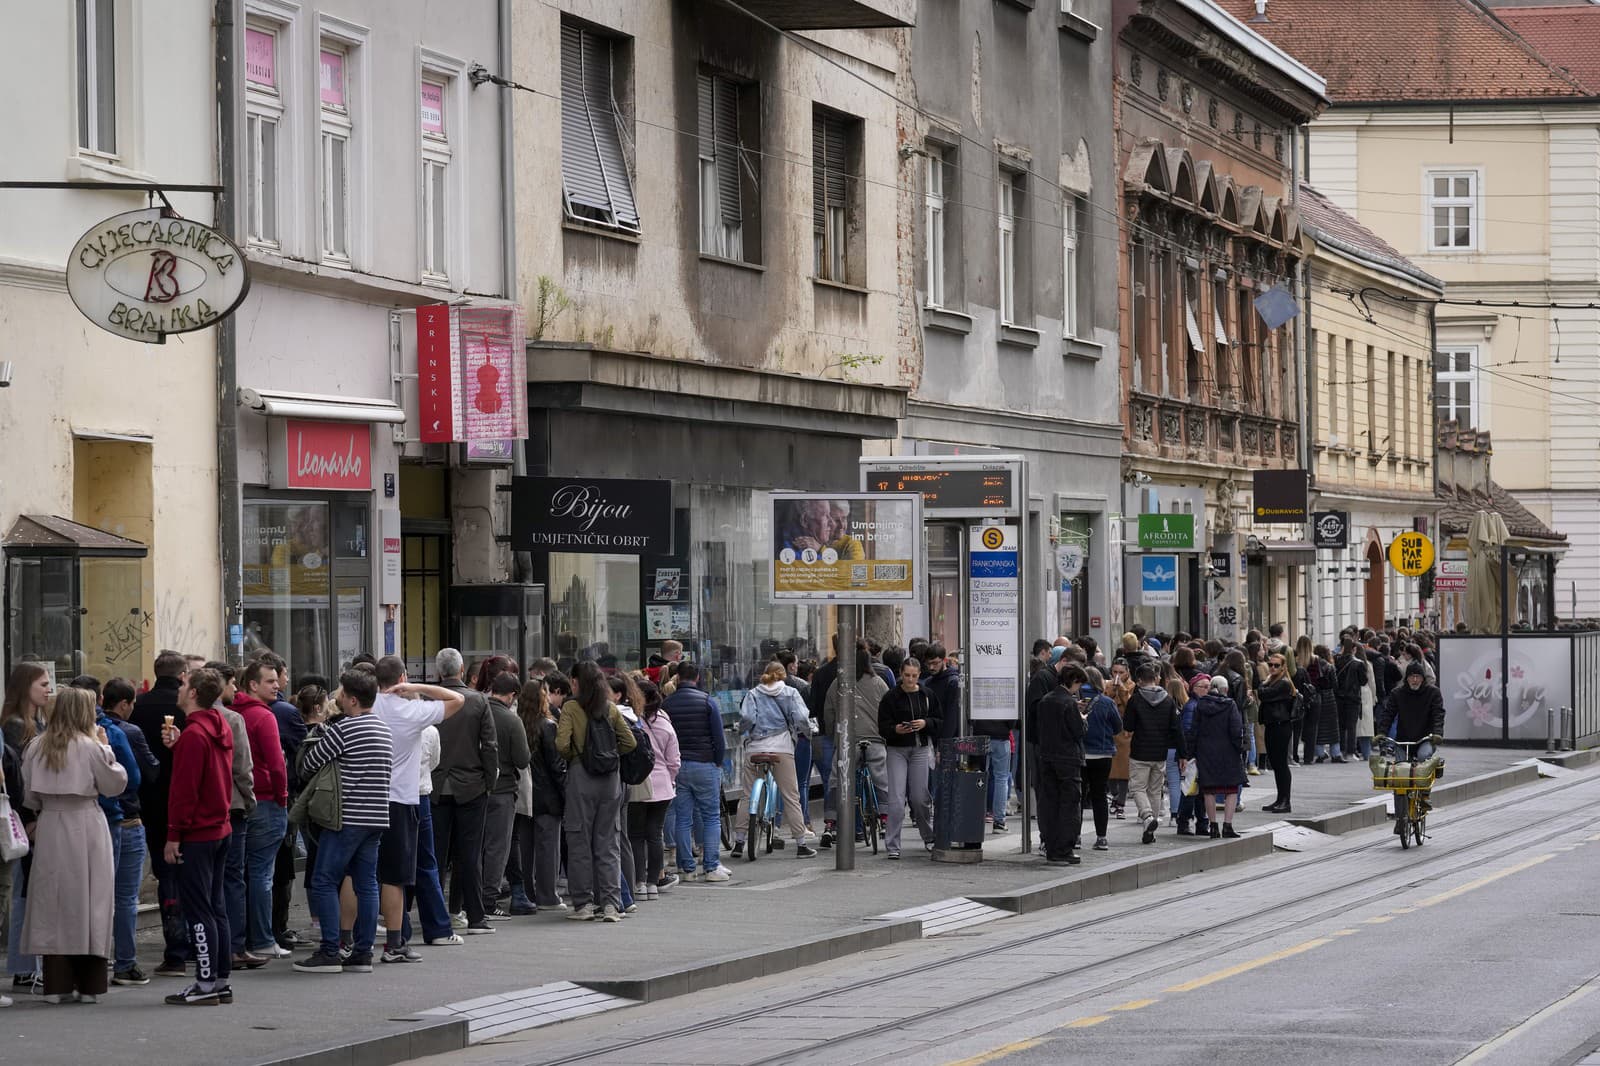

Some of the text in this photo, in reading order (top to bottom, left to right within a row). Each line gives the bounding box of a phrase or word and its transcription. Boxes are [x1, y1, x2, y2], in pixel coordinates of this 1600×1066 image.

[427, 315, 438, 412] ZRINSKI
[298, 431, 362, 478] Leonardo
[551, 484, 632, 532] Bijou
[532, 532, 650, 547] UMJETNIČKI OBRT
[851, 531, 864, 541] im
[988, 532, 998, 545] S
[1143, 533, 1189, 541] AFRODITA
[1401, 537, 1423, 549] SUB
[1401, 547, 1422, 560] MAR
[194, 922, 211, 979] adidas
